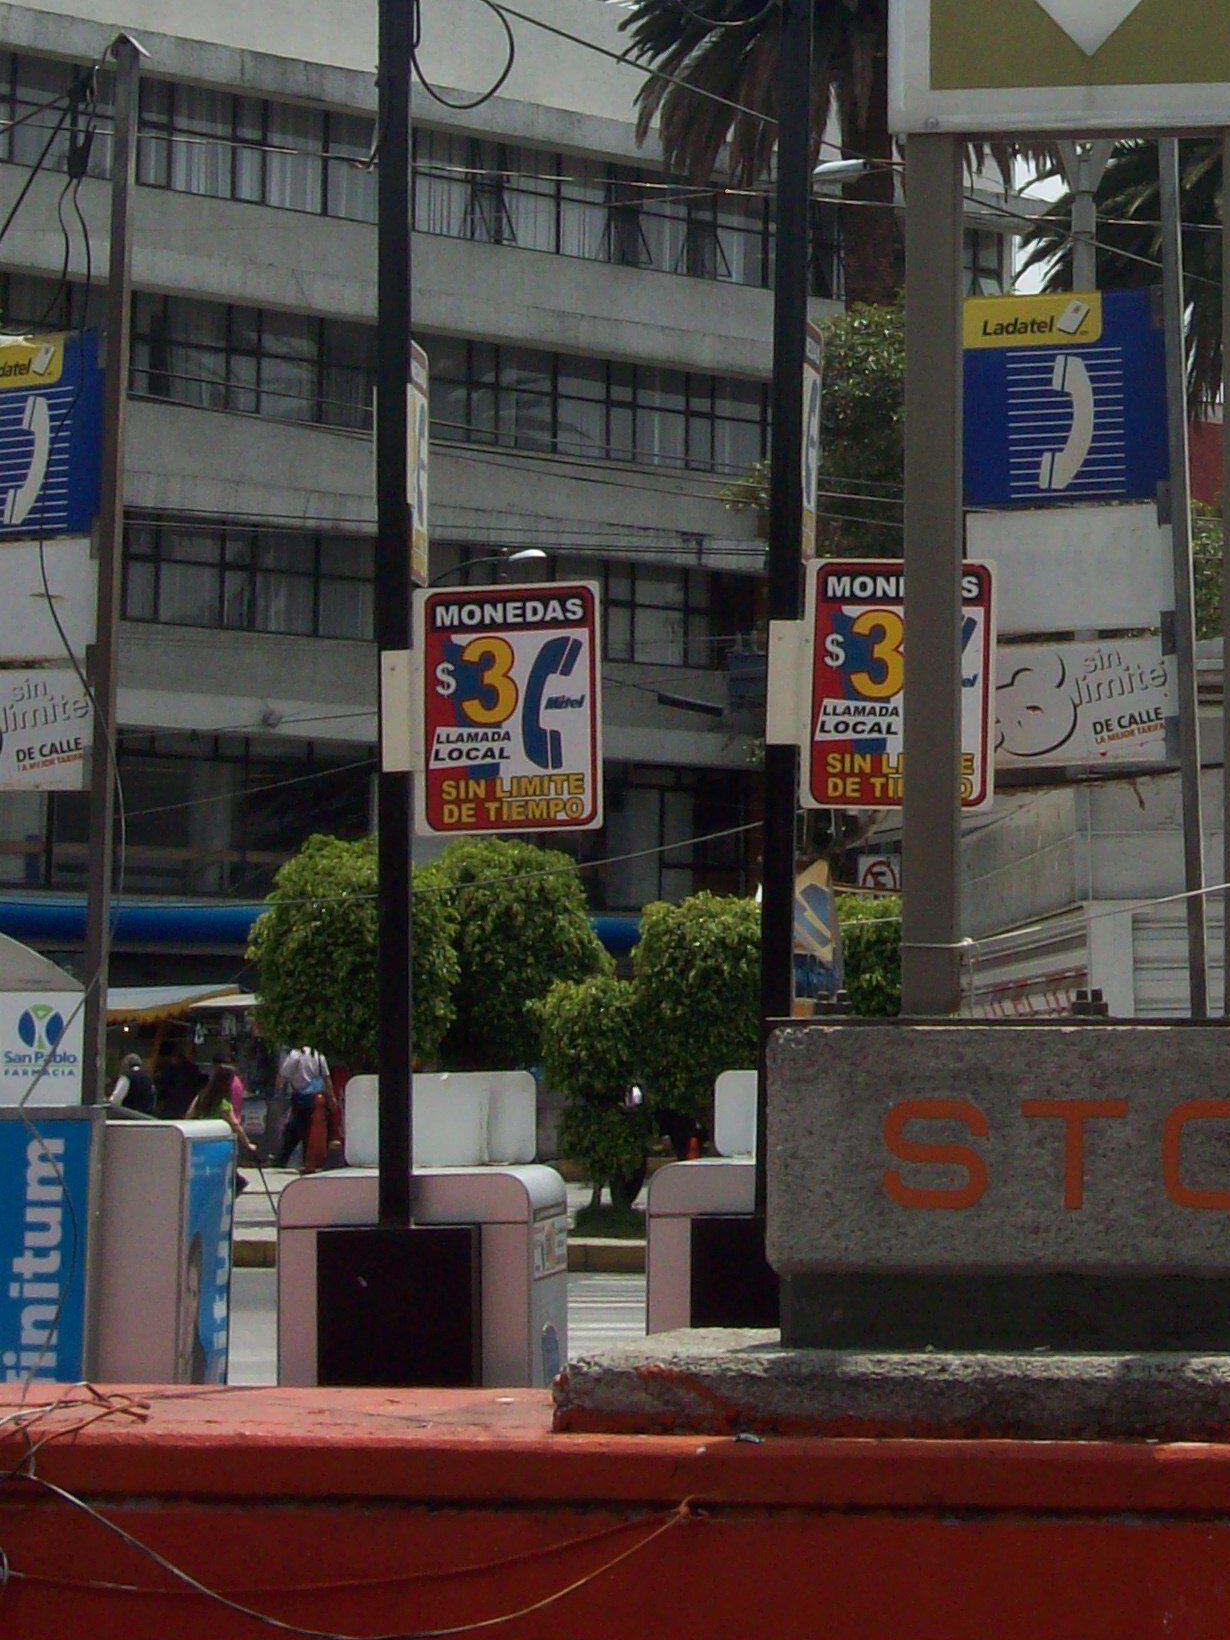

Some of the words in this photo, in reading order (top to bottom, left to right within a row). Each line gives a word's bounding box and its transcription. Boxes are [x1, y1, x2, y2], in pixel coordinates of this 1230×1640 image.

[981, 315, 1055, 337] Ladatel
[826, 575, 980, 599] MONS
[434, 598, 585, 627] MONEDAS
[822, 704, 900, 717] LLAMADA
[1092, 718, 1115, 736] DE
[1117, 707, 1164, 730] CALLE
[436, 730, 512, 744] LLAMADA
[819, 721, 899, 735] LOCAL
[16, 746, 35, 763] DE
[39, 737, 82, 758] CALLE
[433, 747, 511, 762] LOCAL
[825, 752, 872, 775] SIN
[441, 778, 486, 801] SIN
[495, 772, 585, 799] LIMITE
[826, 776, 862, 799] DE
[443, 801, 477, 824] DE
[484, 797, 585, 822] TIEMPO
[4, 1050, 32, 1063] San
[35, 1048, 78, 1064] Pblo
